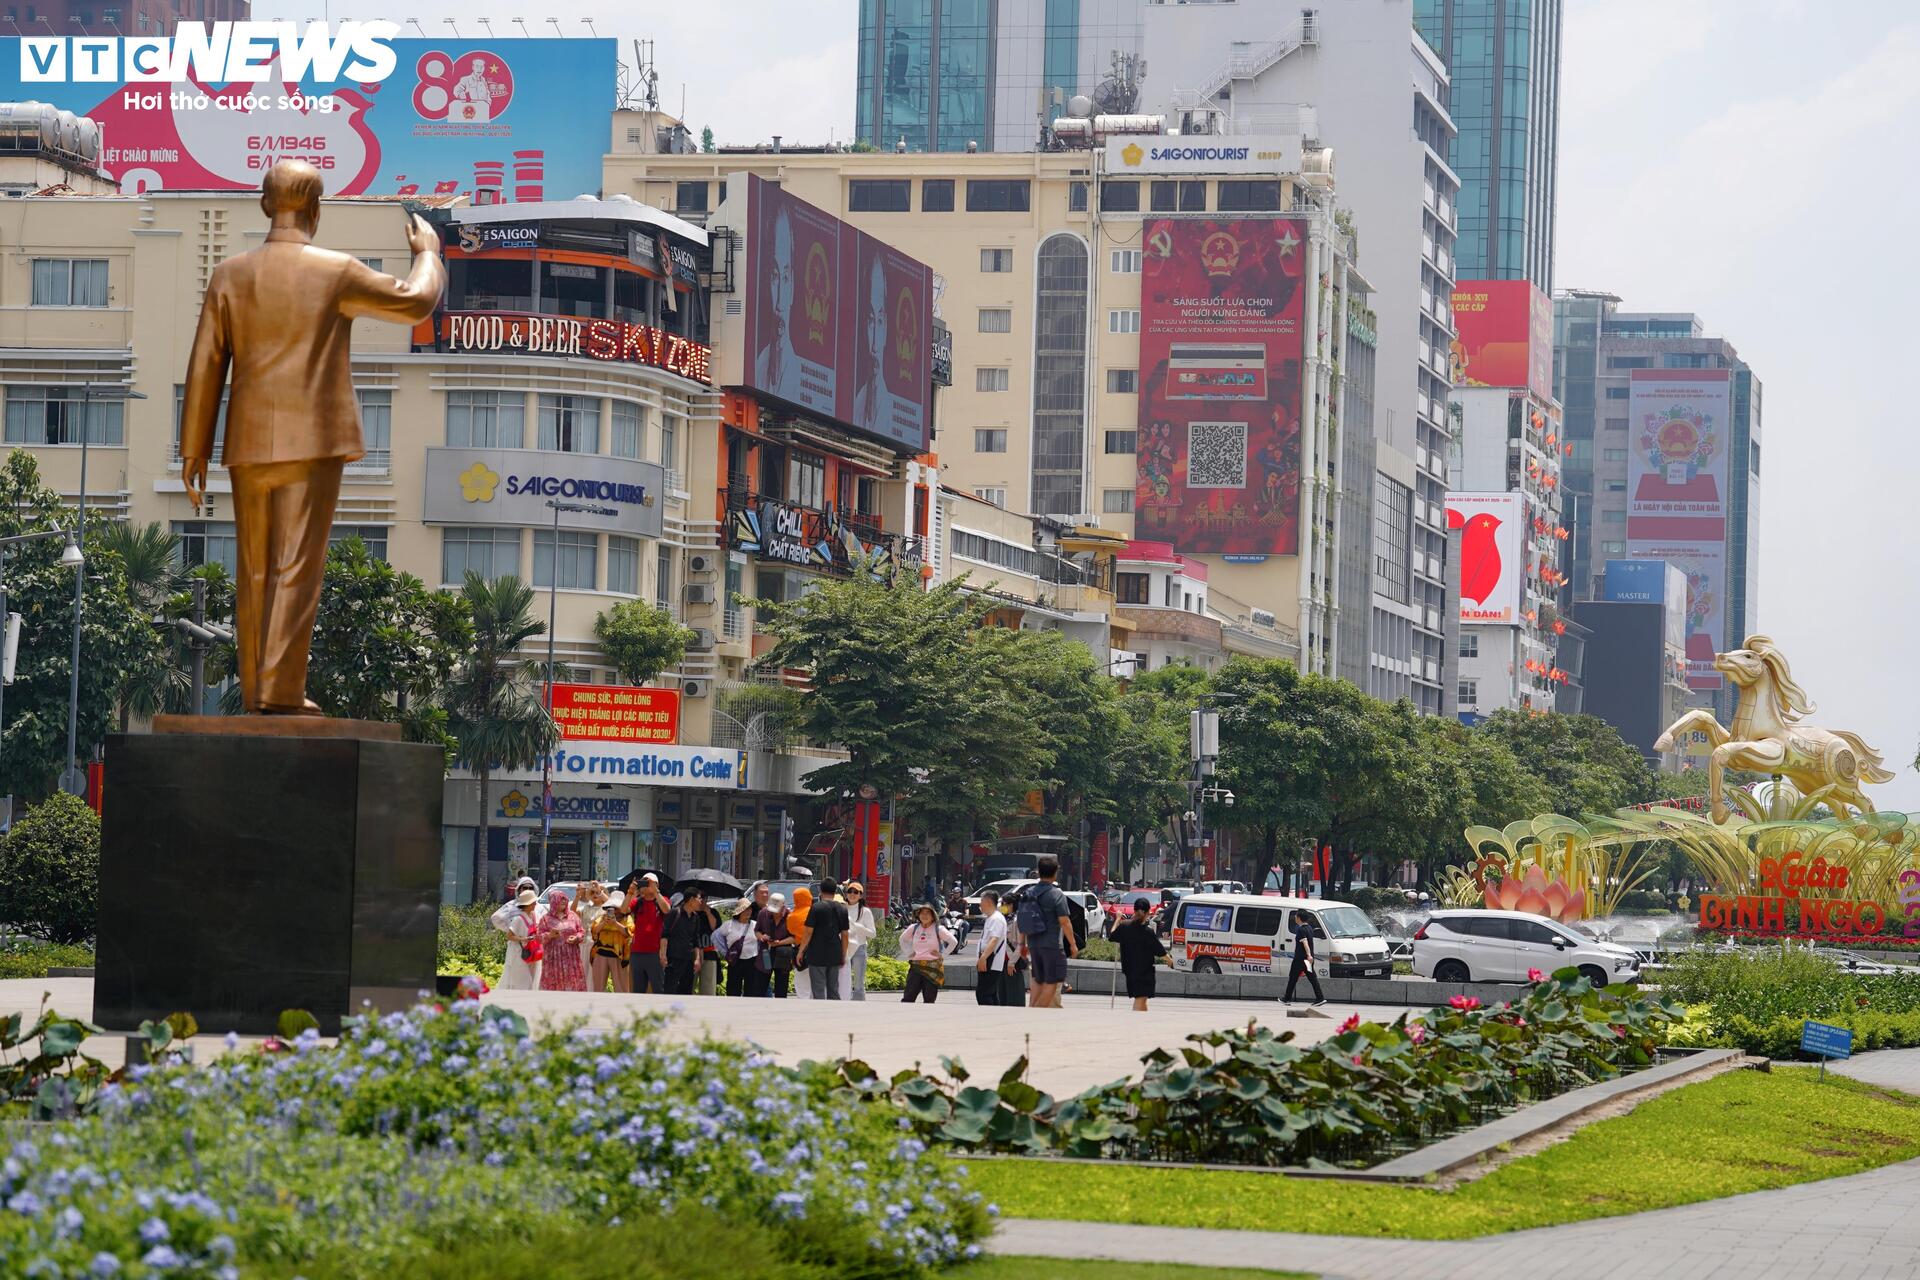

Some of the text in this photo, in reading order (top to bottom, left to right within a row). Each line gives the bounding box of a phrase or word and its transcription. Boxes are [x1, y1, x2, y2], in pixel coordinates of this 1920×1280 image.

[247, 135, 327, 151] 6/1/1946
[103, 147, 179, 165] LIỆT CHÀO MỪNG
[247, 154, 335, 170] 6/1/26
[1151, 147, 1249, 160] SAIGONTOURIST
[490, 228, 538, 240] SAIGON
[674, 246, 696, 271] SAIGON
[1173, 296, 1273, 308] SÁNG SUỐT LỰA CHỌN
[1181, 307, 1266, 317] NGƯỜI XỨNG ĐÁNG
[449, 315, 582, 355] FOOD & BEER
[588, 319, 712, 386] SKY ZONE
[506, 475, 645, 505] SAIGONTOURIST
[776, 508, 803, 538] CHILL
[768, 535, 811, 565] CHẤT RIÊNG
[1617, 592, 1650, 600] MASTERI
[573, 691, 652, 705] CHUNG SỨC, ĐỒNG LÒNG
[552, 706, 669, 724] THỰC HIỆN THẮNG LỢI CÁC MỤC TIÊU
[567, 721, 587, 735] TRIỂN
[588, 722, 600, 736] ĐẤT
[601, 724, 619, 737] NƯỚC
[620, 725, 634, 738] ĐẾN
[635, 726, 651, 738] NĂM
[652, 729, 671, 739] 2030!
[528, 750, 684, 777] nformation
[690, 755, 733, 780] Center
[531, 795, 631, 813] SIGONTOURIST
[1760, 850, 1849, 898] Xuân
[1199, 944, 1246, 956] LALAMOVE
[1240, 964, 1272, 974] HIACE
